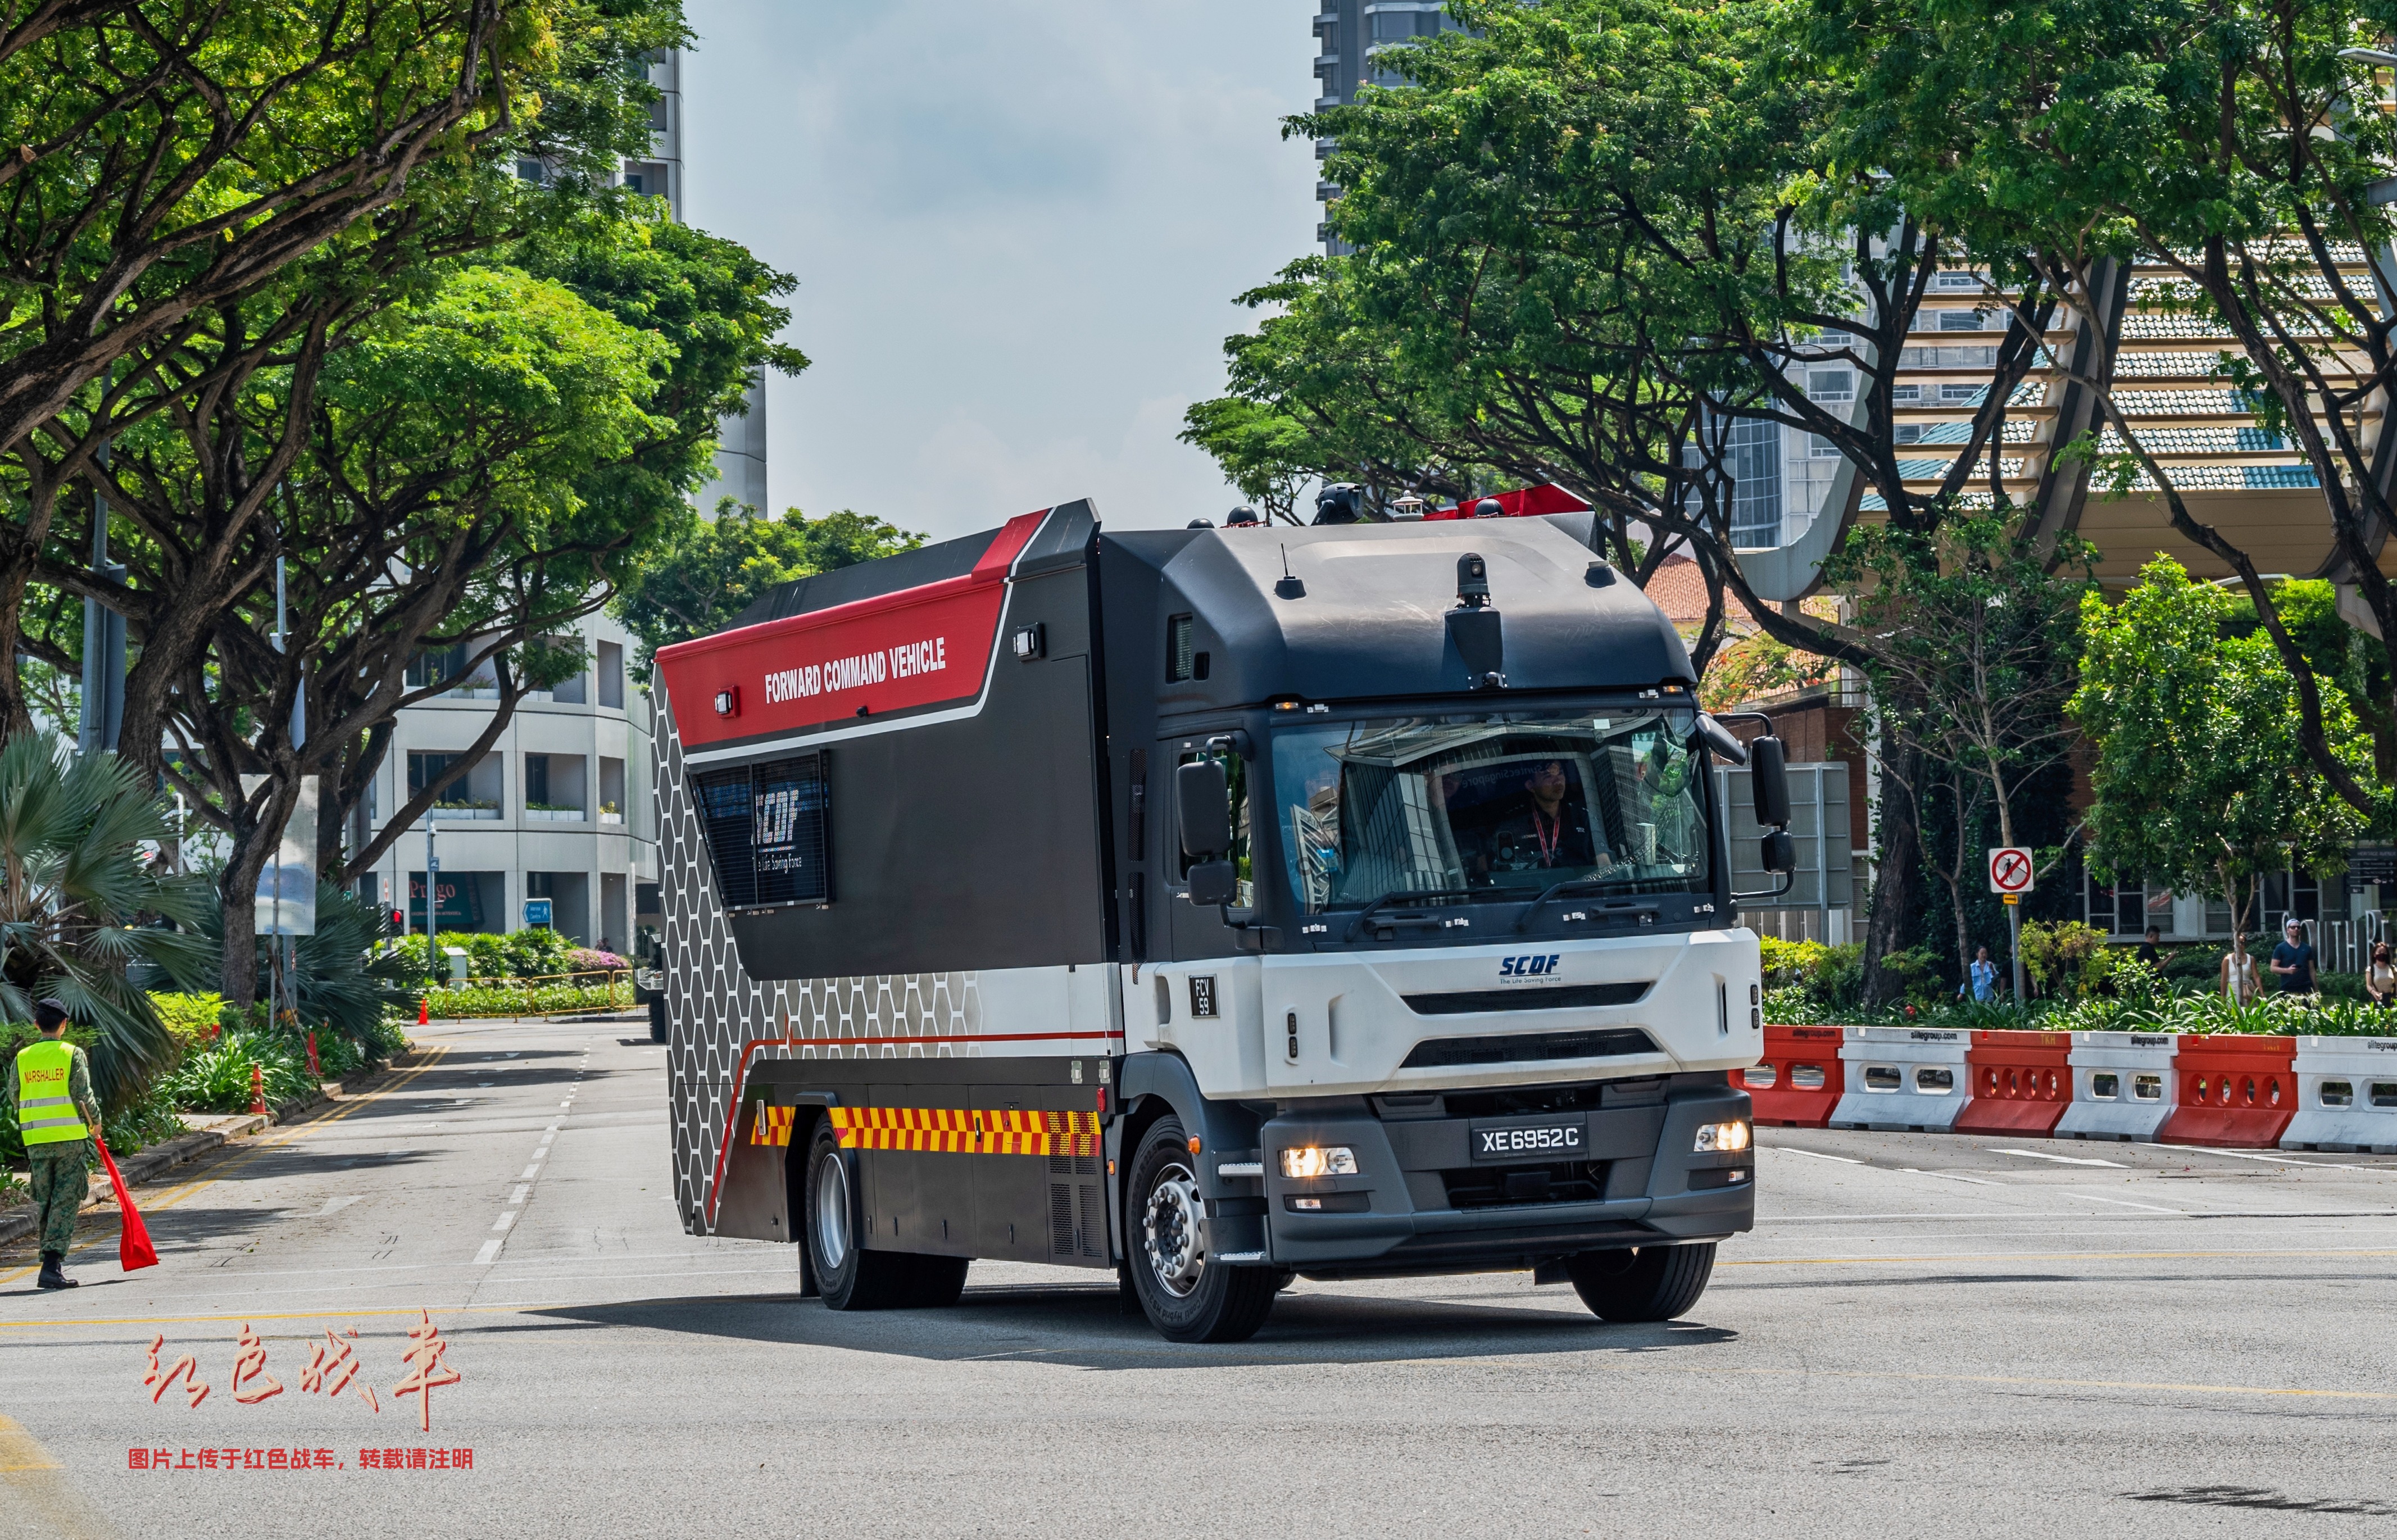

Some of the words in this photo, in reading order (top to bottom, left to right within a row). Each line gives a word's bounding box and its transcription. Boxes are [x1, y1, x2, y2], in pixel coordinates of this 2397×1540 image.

[765, 665, 821, 704] FORWARD
[824, 651, 886, 693] COMMAND
[889, 637, 946, 679] VEHICLE
[751, 789, 799, 845] SCDF
[410, 880, 456, 902] Prgo
[1499, 955, 1560, 975] SCDF
[1195, 979, 1209, 997] FCV
[1199, 997, 1209, 1015] 59
[2041, 1034, 2055, 1045] TKH
[1482, 1128, 1579, 1152] XE6952C
